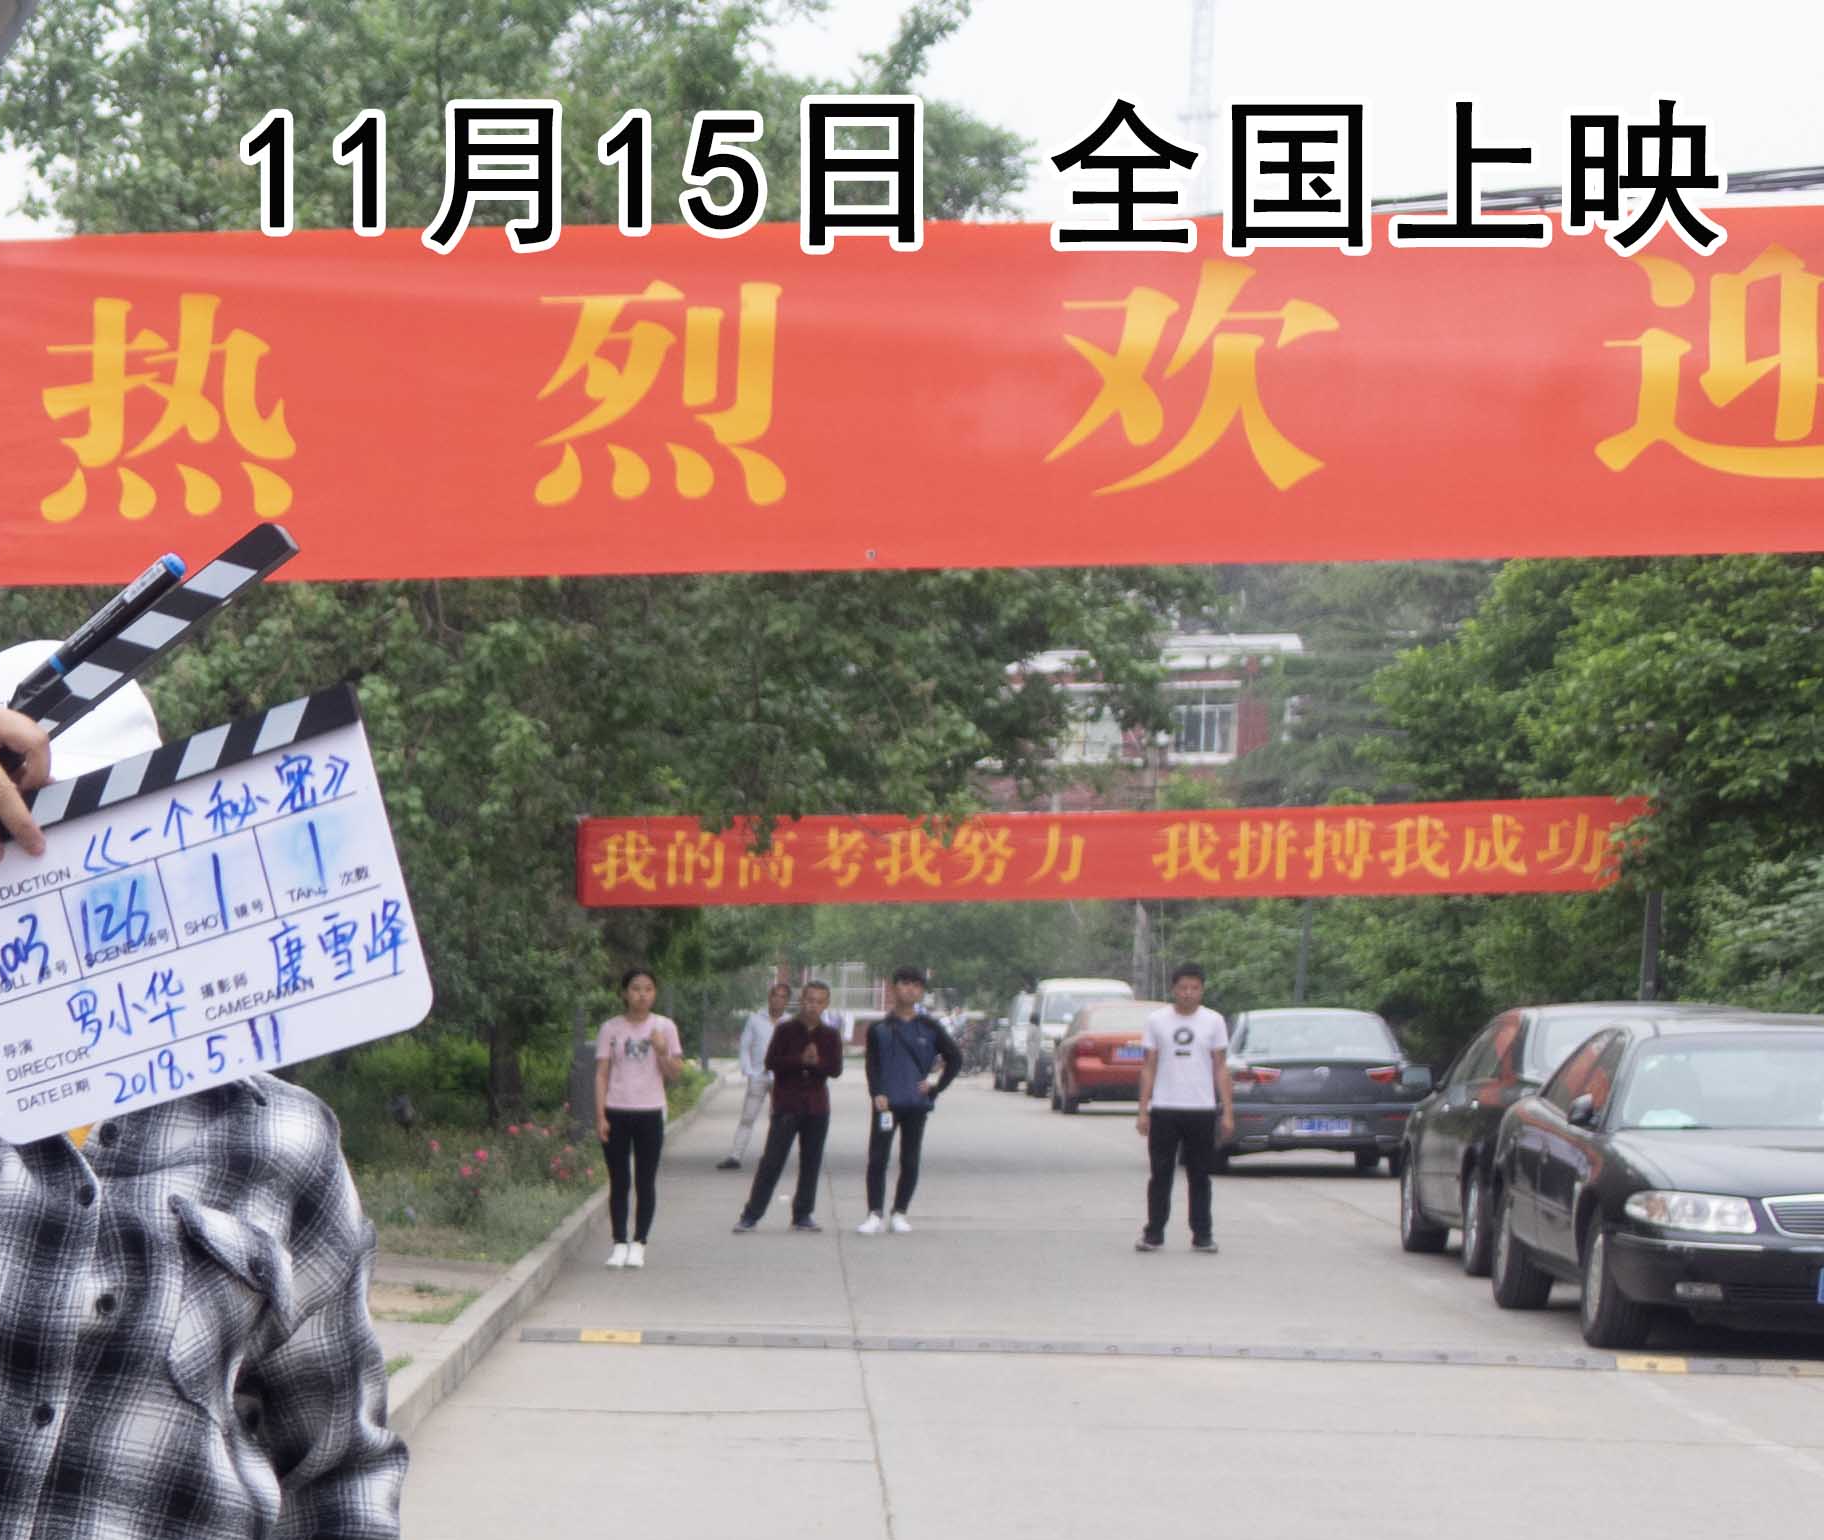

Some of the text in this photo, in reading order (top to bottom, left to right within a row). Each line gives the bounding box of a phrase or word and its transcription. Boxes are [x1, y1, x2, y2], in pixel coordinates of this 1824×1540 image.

[40, 240, 1824, 525] 热烈欢迎
[592, 813, 1608, 892] 我的高考我努力 我拼搏我成功
[80, 879, 151, 967] 126
[66, 970, 186, 1048] 罗小华
[6, 1044, 89, 1083] DIRECTOR
